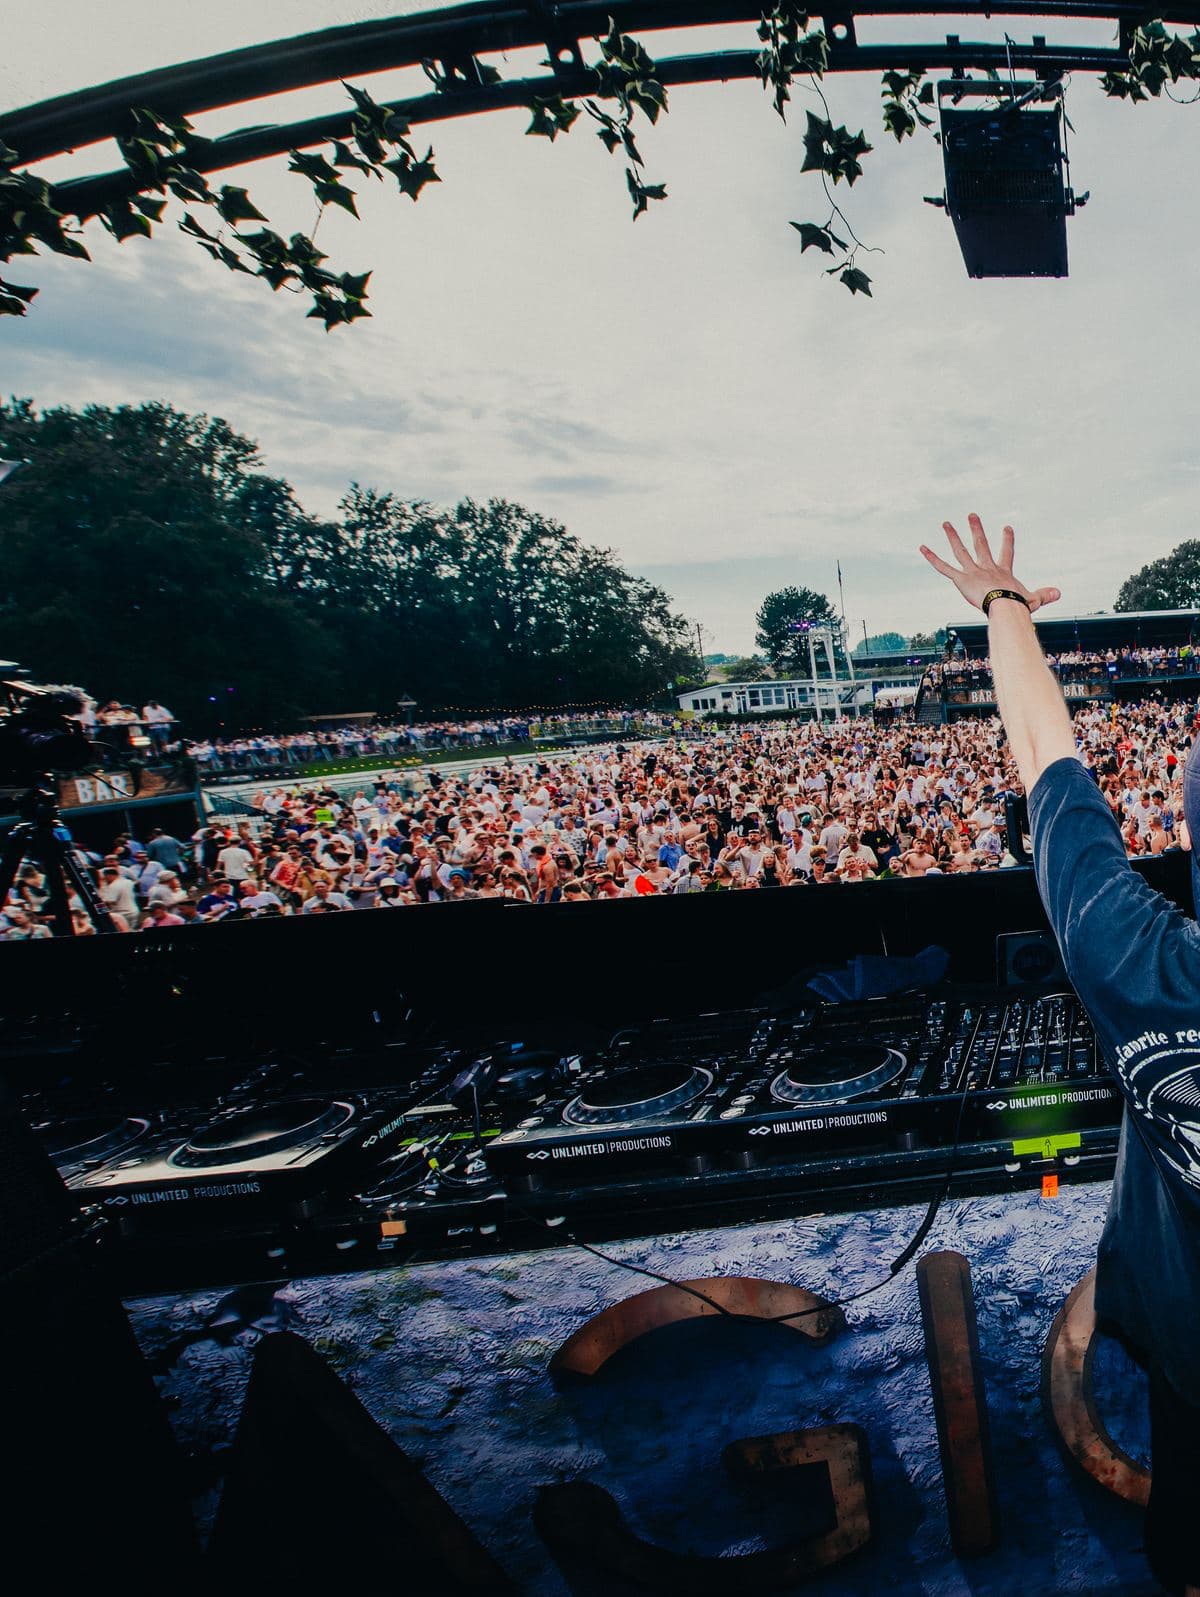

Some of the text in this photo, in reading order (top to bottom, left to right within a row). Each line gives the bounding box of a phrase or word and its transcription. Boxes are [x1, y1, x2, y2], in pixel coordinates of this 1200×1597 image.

[971, 689, 993, 703] BAR
[1063, 684, 1085, 697] BAR
[74, 774, 128, 804] BAR
[1009, 1088, 1115, 1109] UNLIMITED PRODUCTION
[772, 1111, 888, 1135] UNLIMITED PRODUCTIONS
[552, 1136, 672, 1159] UNLIMITED PRODUCTIONS
[131, 1181, 261, 1205] UNLIMITED PRODUCTIONS
